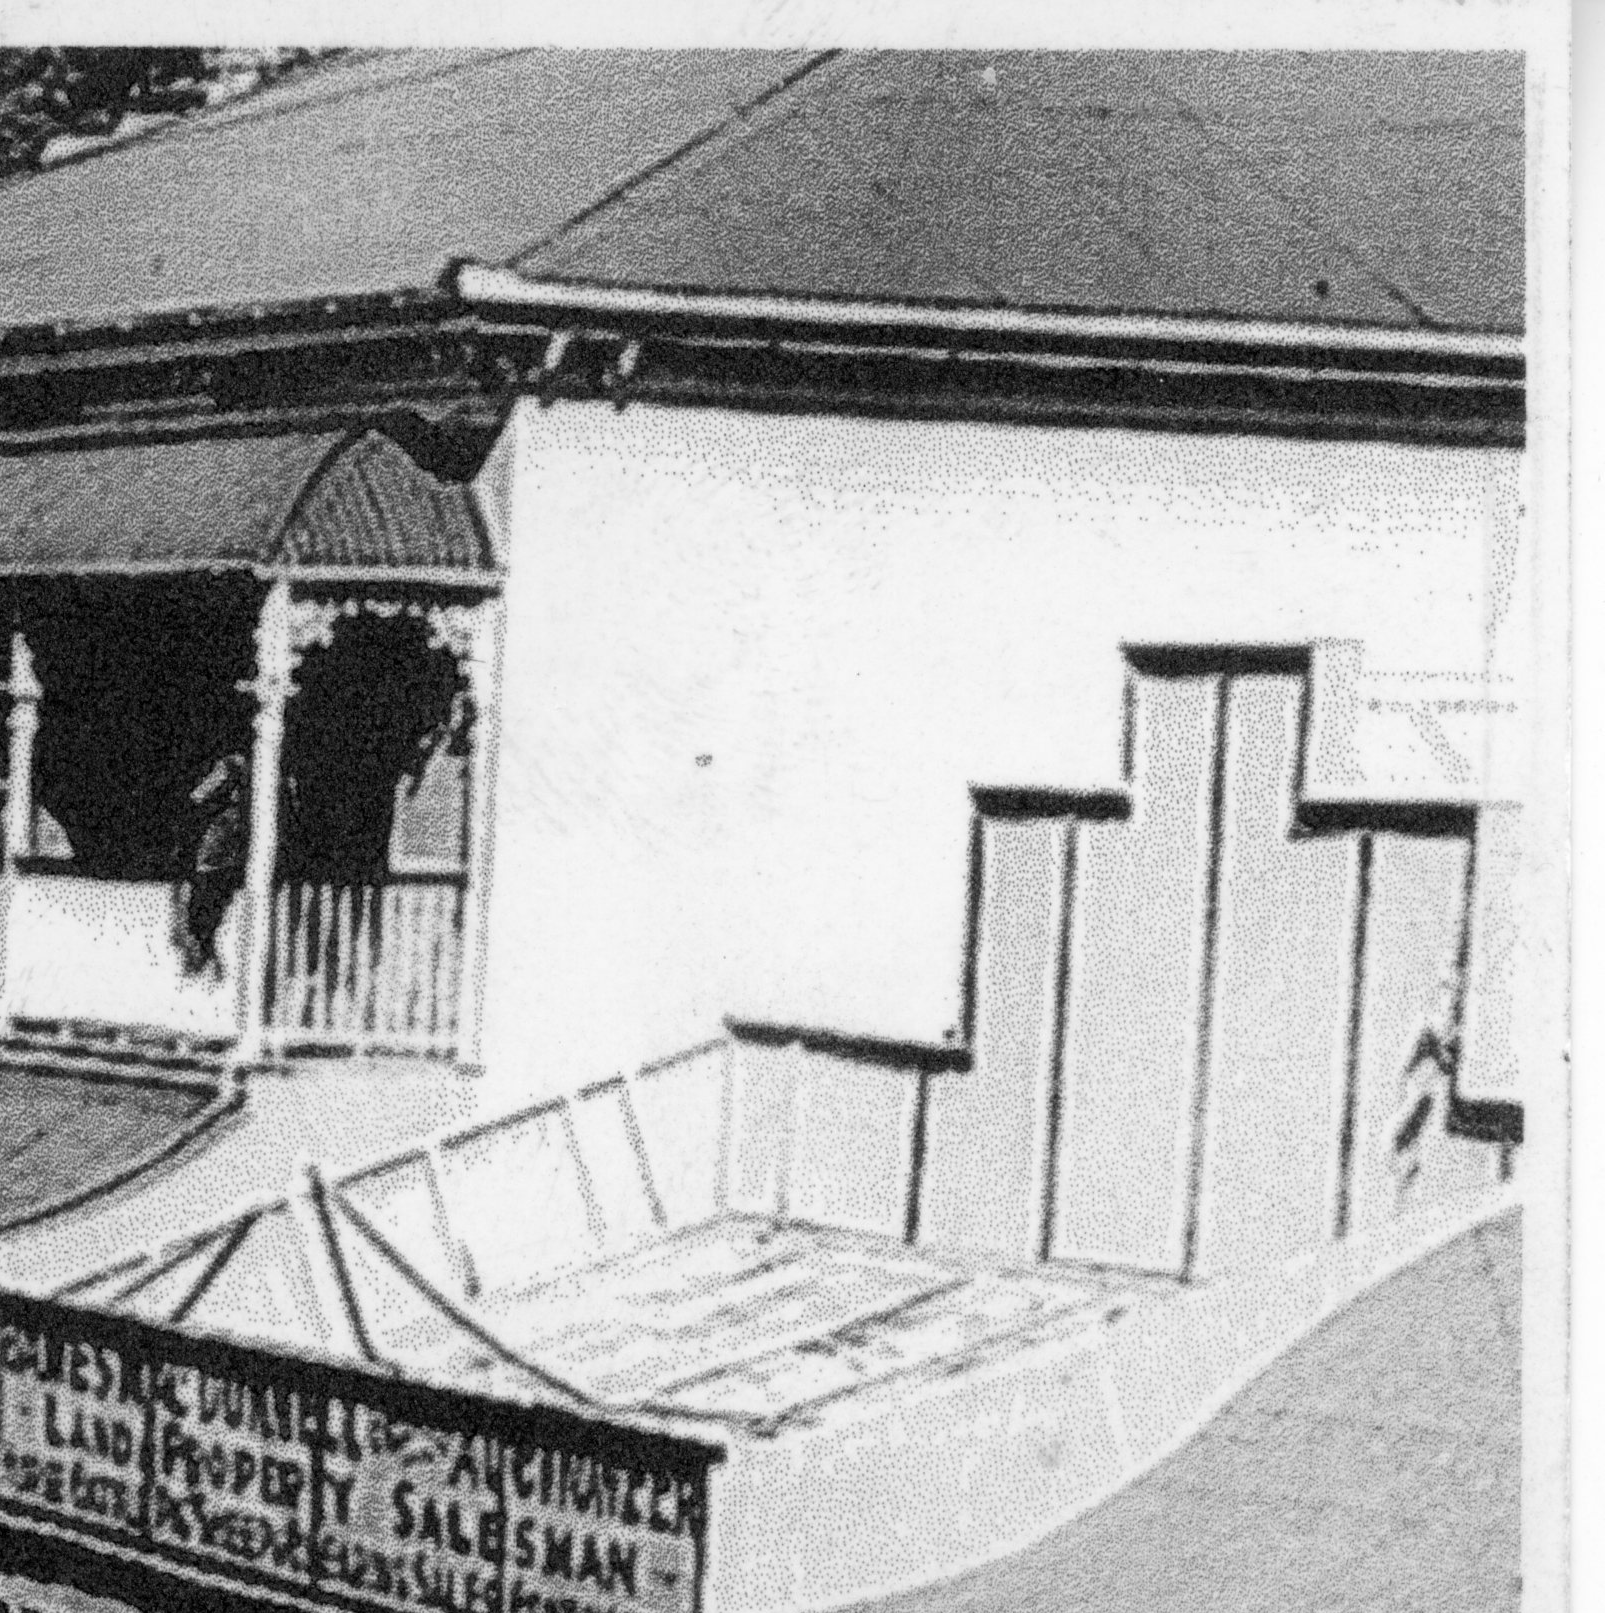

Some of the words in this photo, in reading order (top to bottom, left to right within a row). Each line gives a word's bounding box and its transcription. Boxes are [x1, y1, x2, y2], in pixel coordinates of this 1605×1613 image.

[44, 1393, 136, 1468] LAND
[153, 1417, 353, 1530] PROPERTY
[392, 1480, 639, 1598] SALESMAN
